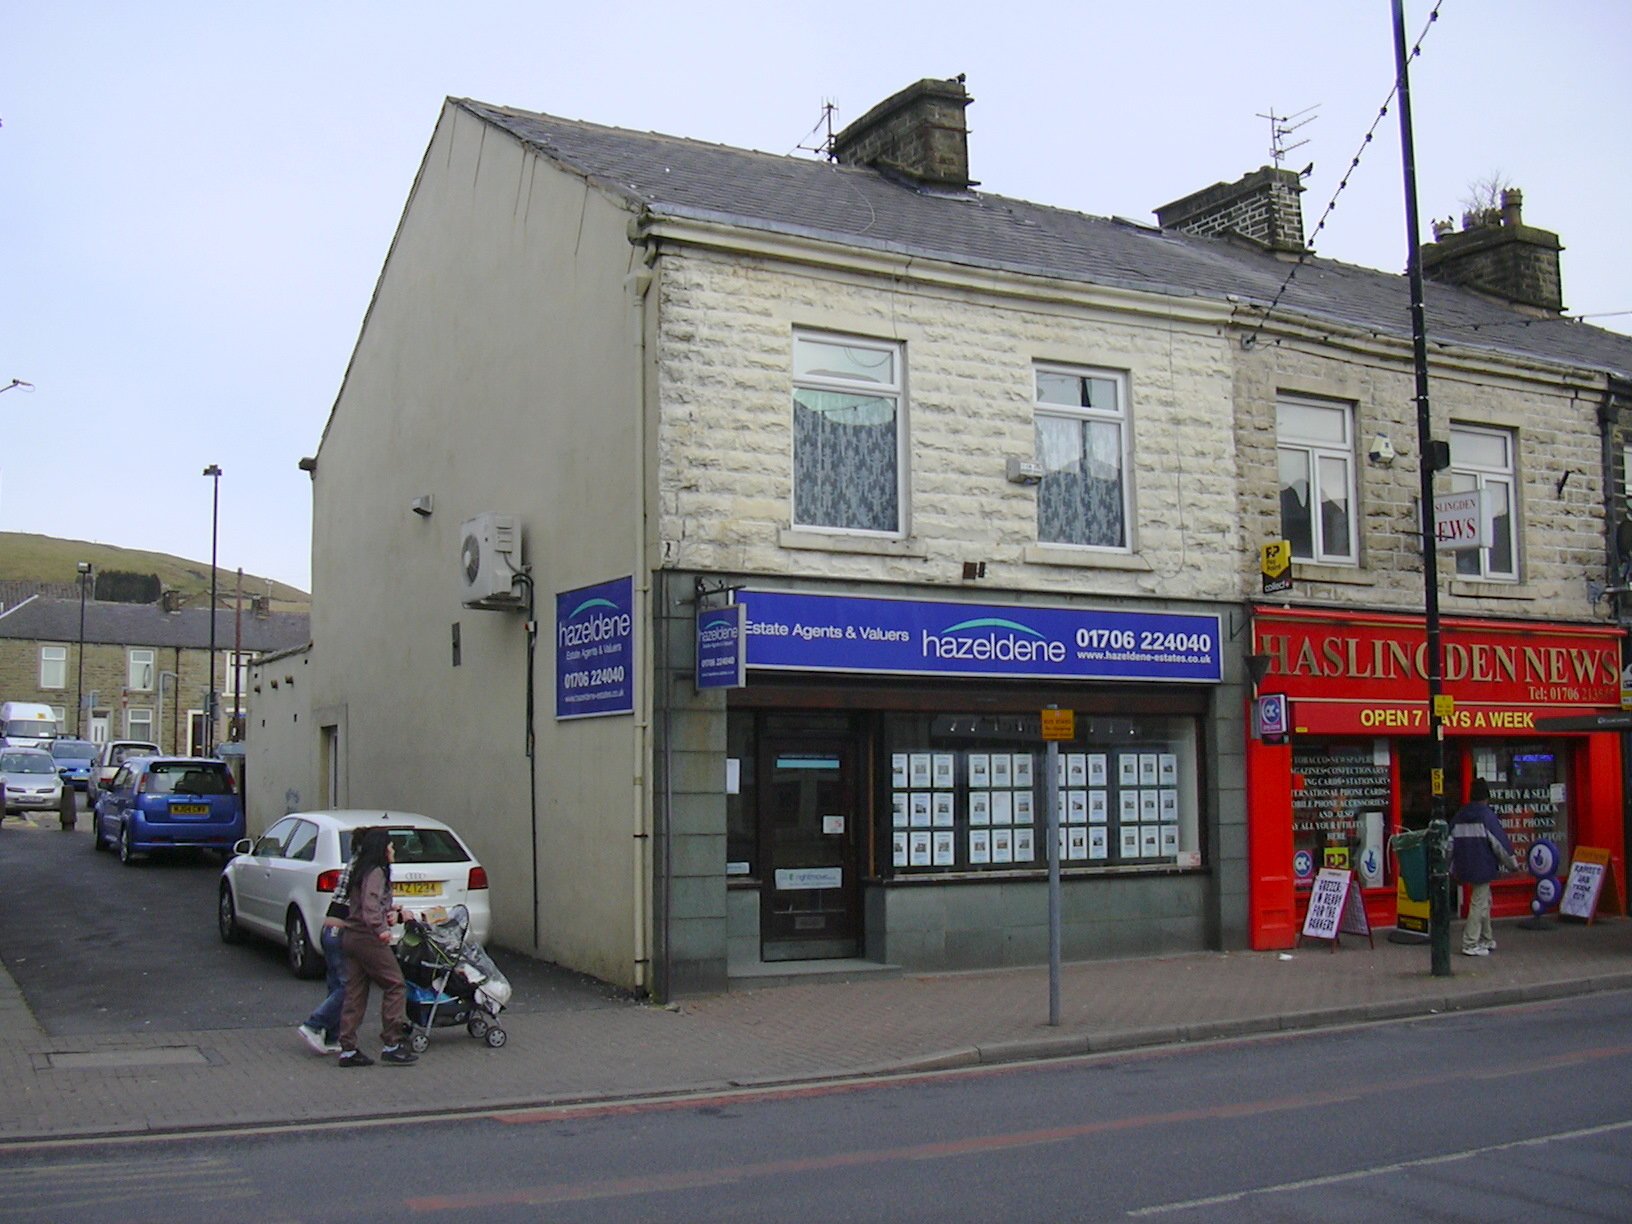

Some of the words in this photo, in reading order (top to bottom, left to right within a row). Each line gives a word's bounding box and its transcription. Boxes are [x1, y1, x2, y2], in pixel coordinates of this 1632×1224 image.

[1435, 499, 1476, 512] SLINGDEN
[1437, 518, 1476, 541] EWS
[559, 612, 631, 648] hazeldene
[699, 626, 738, 642] hazeldene
[745, 621, 789, 635] Estate
[792, 623, 842, 640] Agents
[845, 626, 857, 639] &
[859, 627, 909, 641] Valuers
[923, 629, 1065, 662] hazeldene
[1076, 628, 1135, 649] 01706
[1140, 632, 1211, 652] 224040
[1077, 650, 1212, 664] www.hazeldene-estates.co.uk
[1524, 647, 1618, 685] NEWS
[564, 671, 589, 689] 01706
[590, 665, 625, 686] 224040
[1550, 686, 1579, 701] 01706
[1361, 709, 1408, 726] OPEN
[1412, 710, 1423, 726] 7
[1427, 712, 1470, 728] AYS
[1474, 712, 1486, 728] A
[1489, 712, 1534, 728] WEEK
[1505, 788, 1522, 799] BUY
[1292, 799, 1312, 808] OBILE
